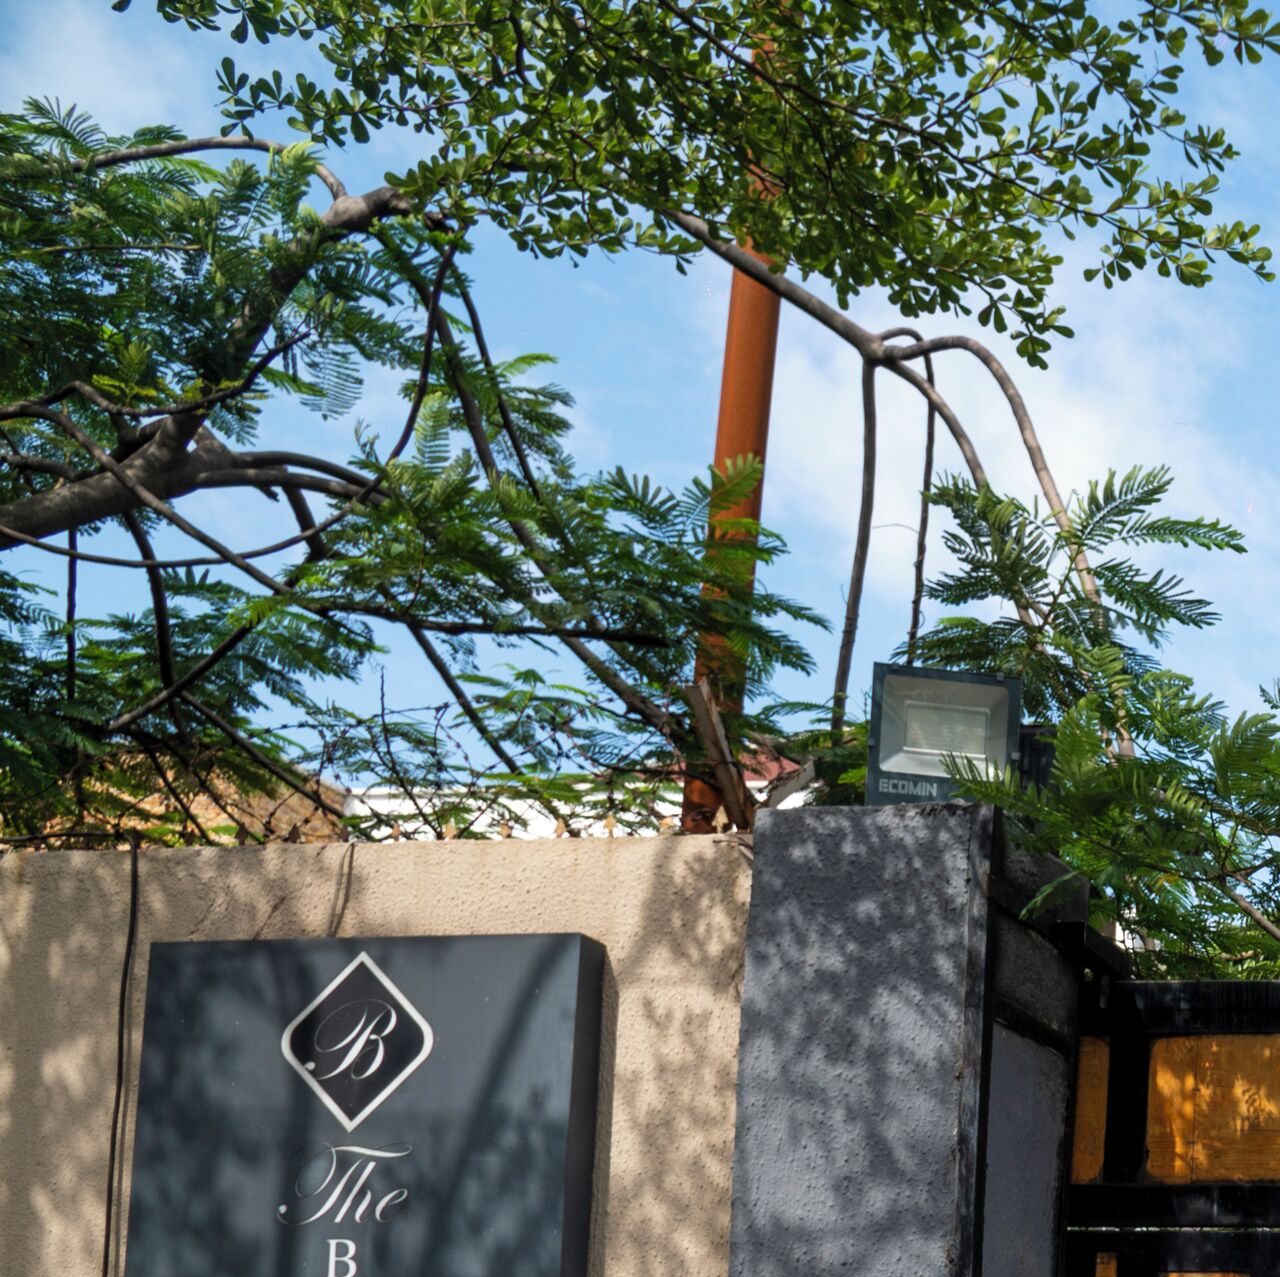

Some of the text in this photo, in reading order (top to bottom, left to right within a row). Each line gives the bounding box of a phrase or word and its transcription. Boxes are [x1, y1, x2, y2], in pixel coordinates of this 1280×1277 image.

[879, 778, 938, 797] ECOMIN
[303, 998, 398, 1081] B
[277, 1142, 414, 1226] The
